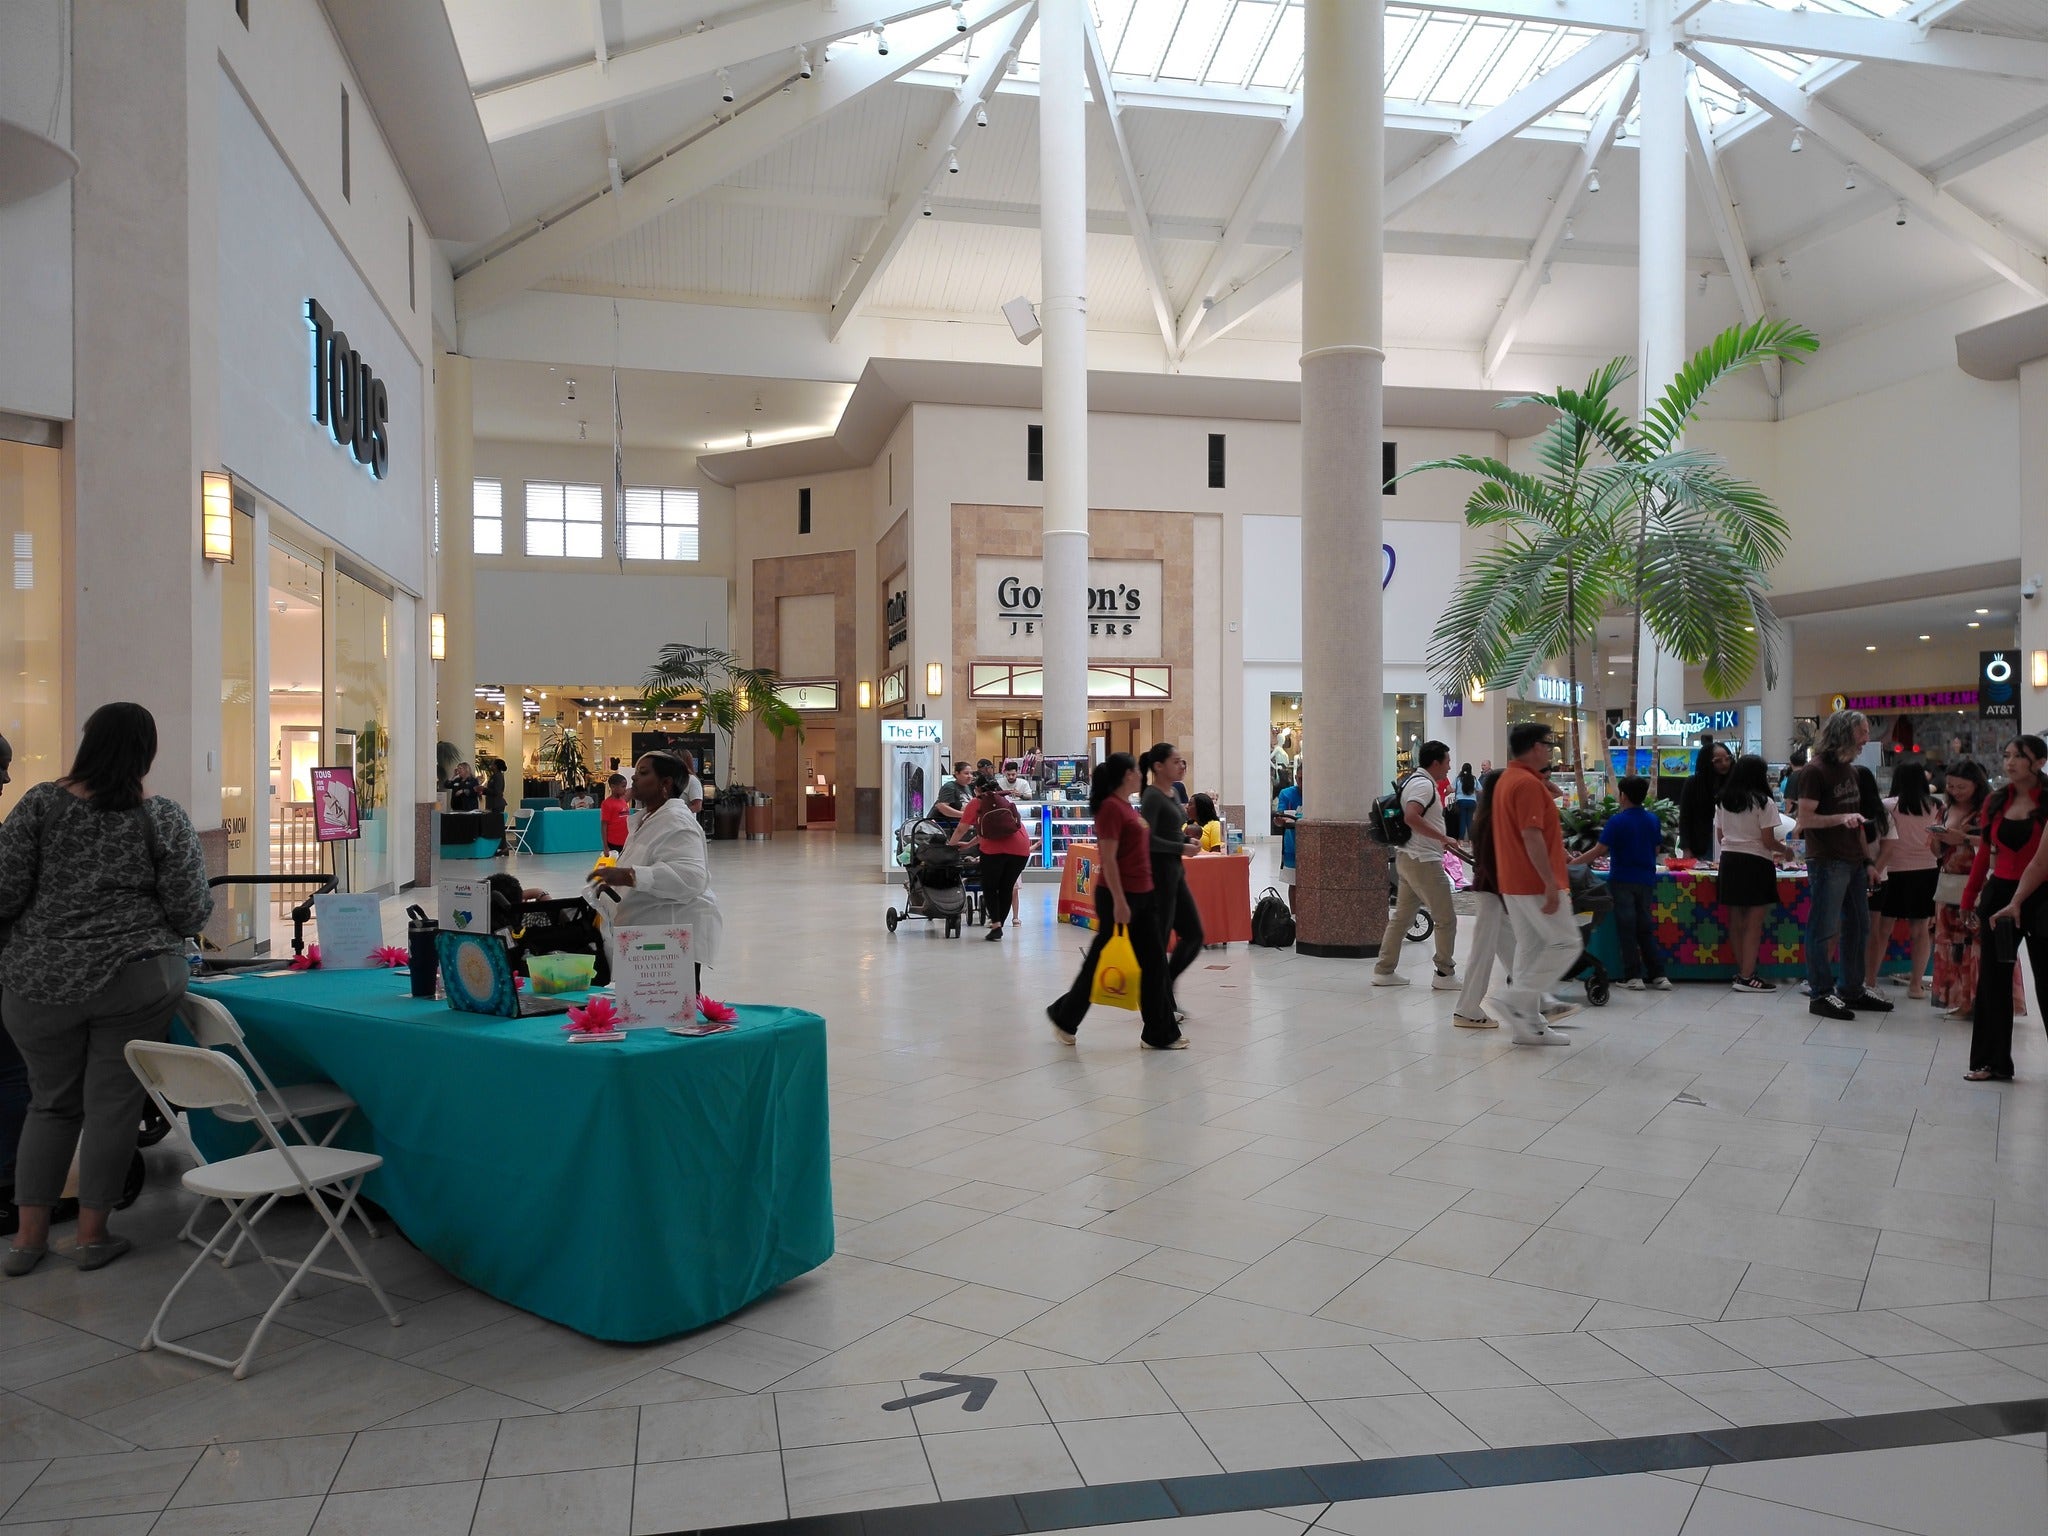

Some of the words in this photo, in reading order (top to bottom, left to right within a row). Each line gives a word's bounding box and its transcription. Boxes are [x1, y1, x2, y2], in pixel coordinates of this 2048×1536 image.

[307, 298, 389, 480] TOUS
[997, 576, 1141, 611] Gon's
[1010, 622, 1133, 635] JEERS
[1849, 695, 1892, 709] MARBLE
[1896, 694, 1926, 708] SLAB
[1986, 705, 2015, 715] AT&T
[1688, 711, 1710, 729] The
[1714, 710, 1735, 731] FIX
[888, 725, 913, 738] The
[918, 725, 937, 740] FIX
[315, 770, 332, 779] TOUS
[233, 816, 247, 833] MOM
